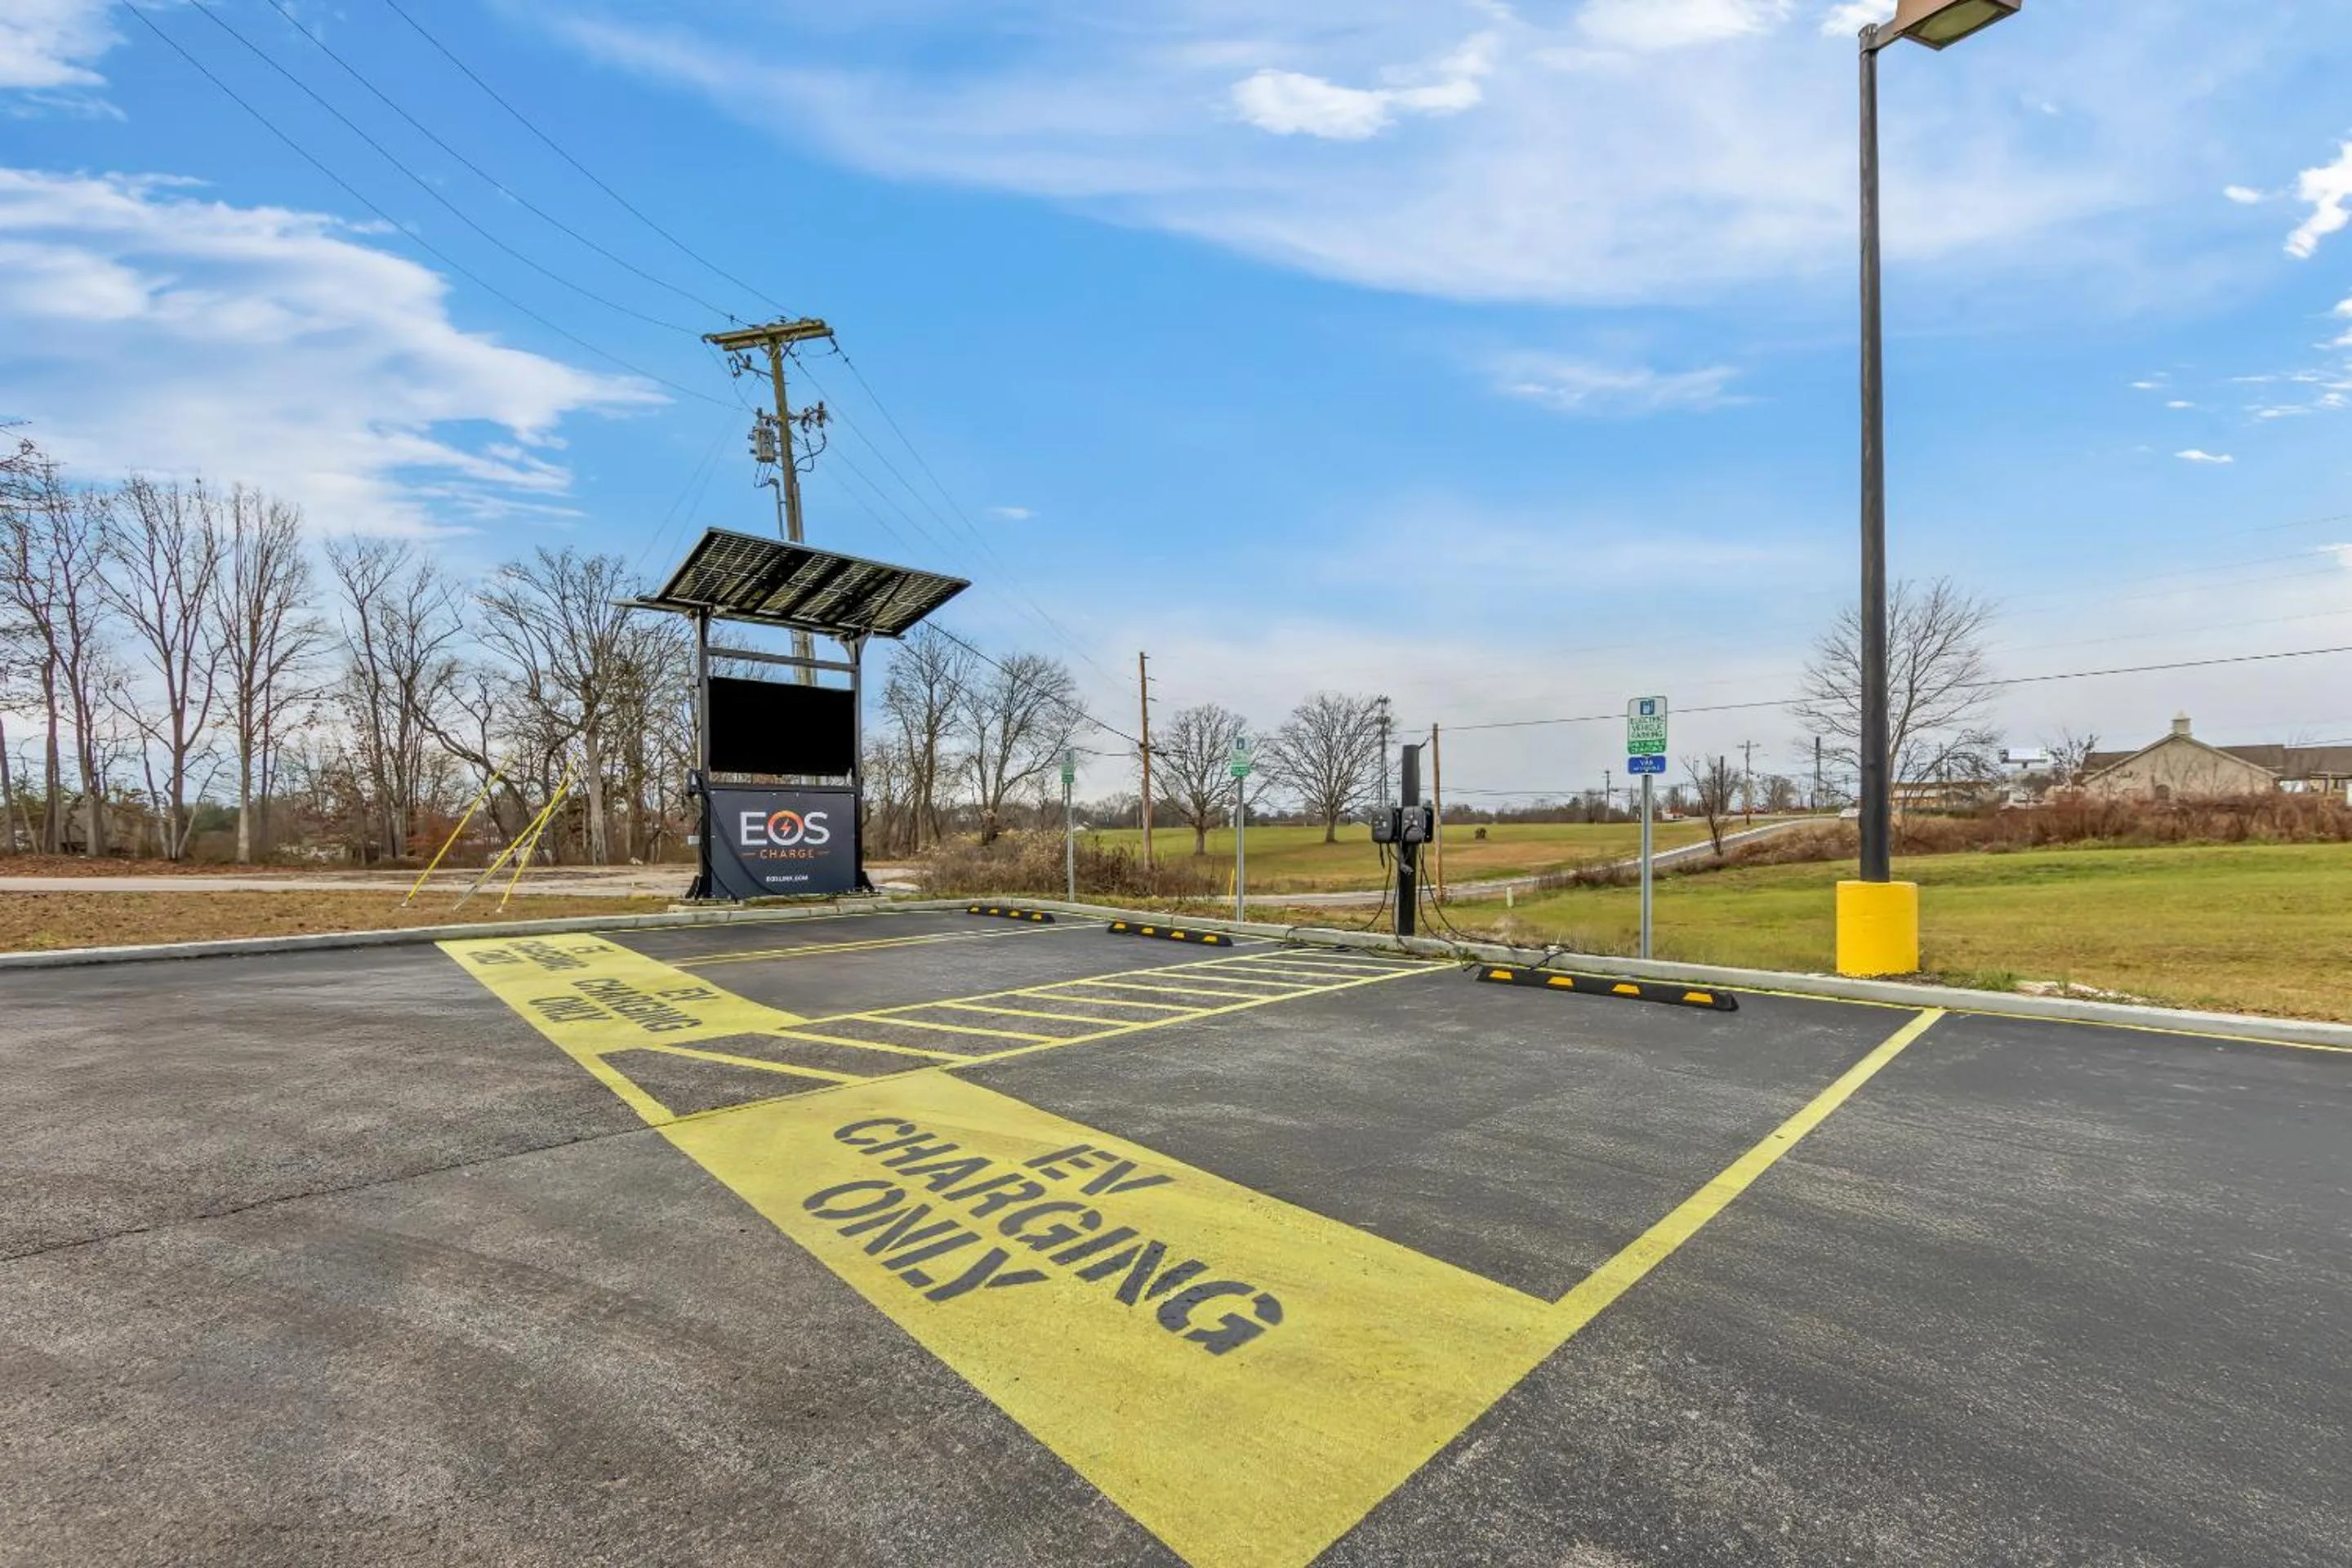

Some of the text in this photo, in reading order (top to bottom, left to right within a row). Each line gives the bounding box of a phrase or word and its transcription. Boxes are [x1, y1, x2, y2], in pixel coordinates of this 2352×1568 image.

[740, 810, 831, 845] EOS
[760, 849, 814, 859] CHARGE
[528, 996, 615, 1022] ONLY
[572, 978, 702, 1032] CHARGING
[1022, 1144, 1176, 1196] EV
[802, 1180, 1051, 1302] ONLY
[833, 1117, 1283, 1356] CHARGING
